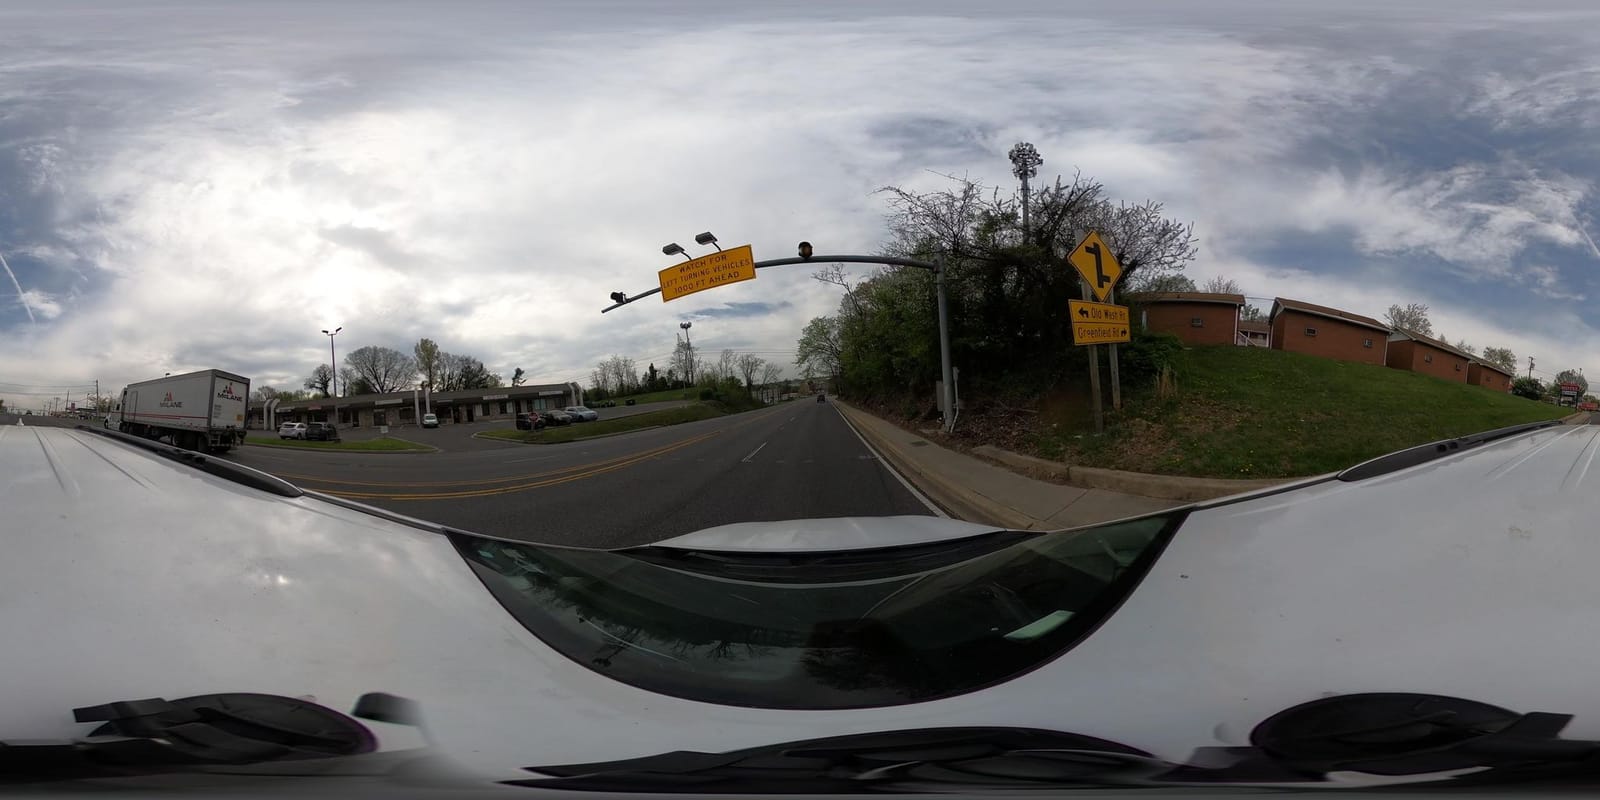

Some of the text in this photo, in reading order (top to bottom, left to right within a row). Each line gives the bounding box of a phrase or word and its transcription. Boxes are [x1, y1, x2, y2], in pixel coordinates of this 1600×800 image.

[662, 259, 750, 289] LEFT TURNING VEHICLES
[679, 254, 727, 273] WATCH FOR
[674, 271, 740, 295] 1000 FT AHEAD
[1078, 327, 1111, 338] Greenfield
